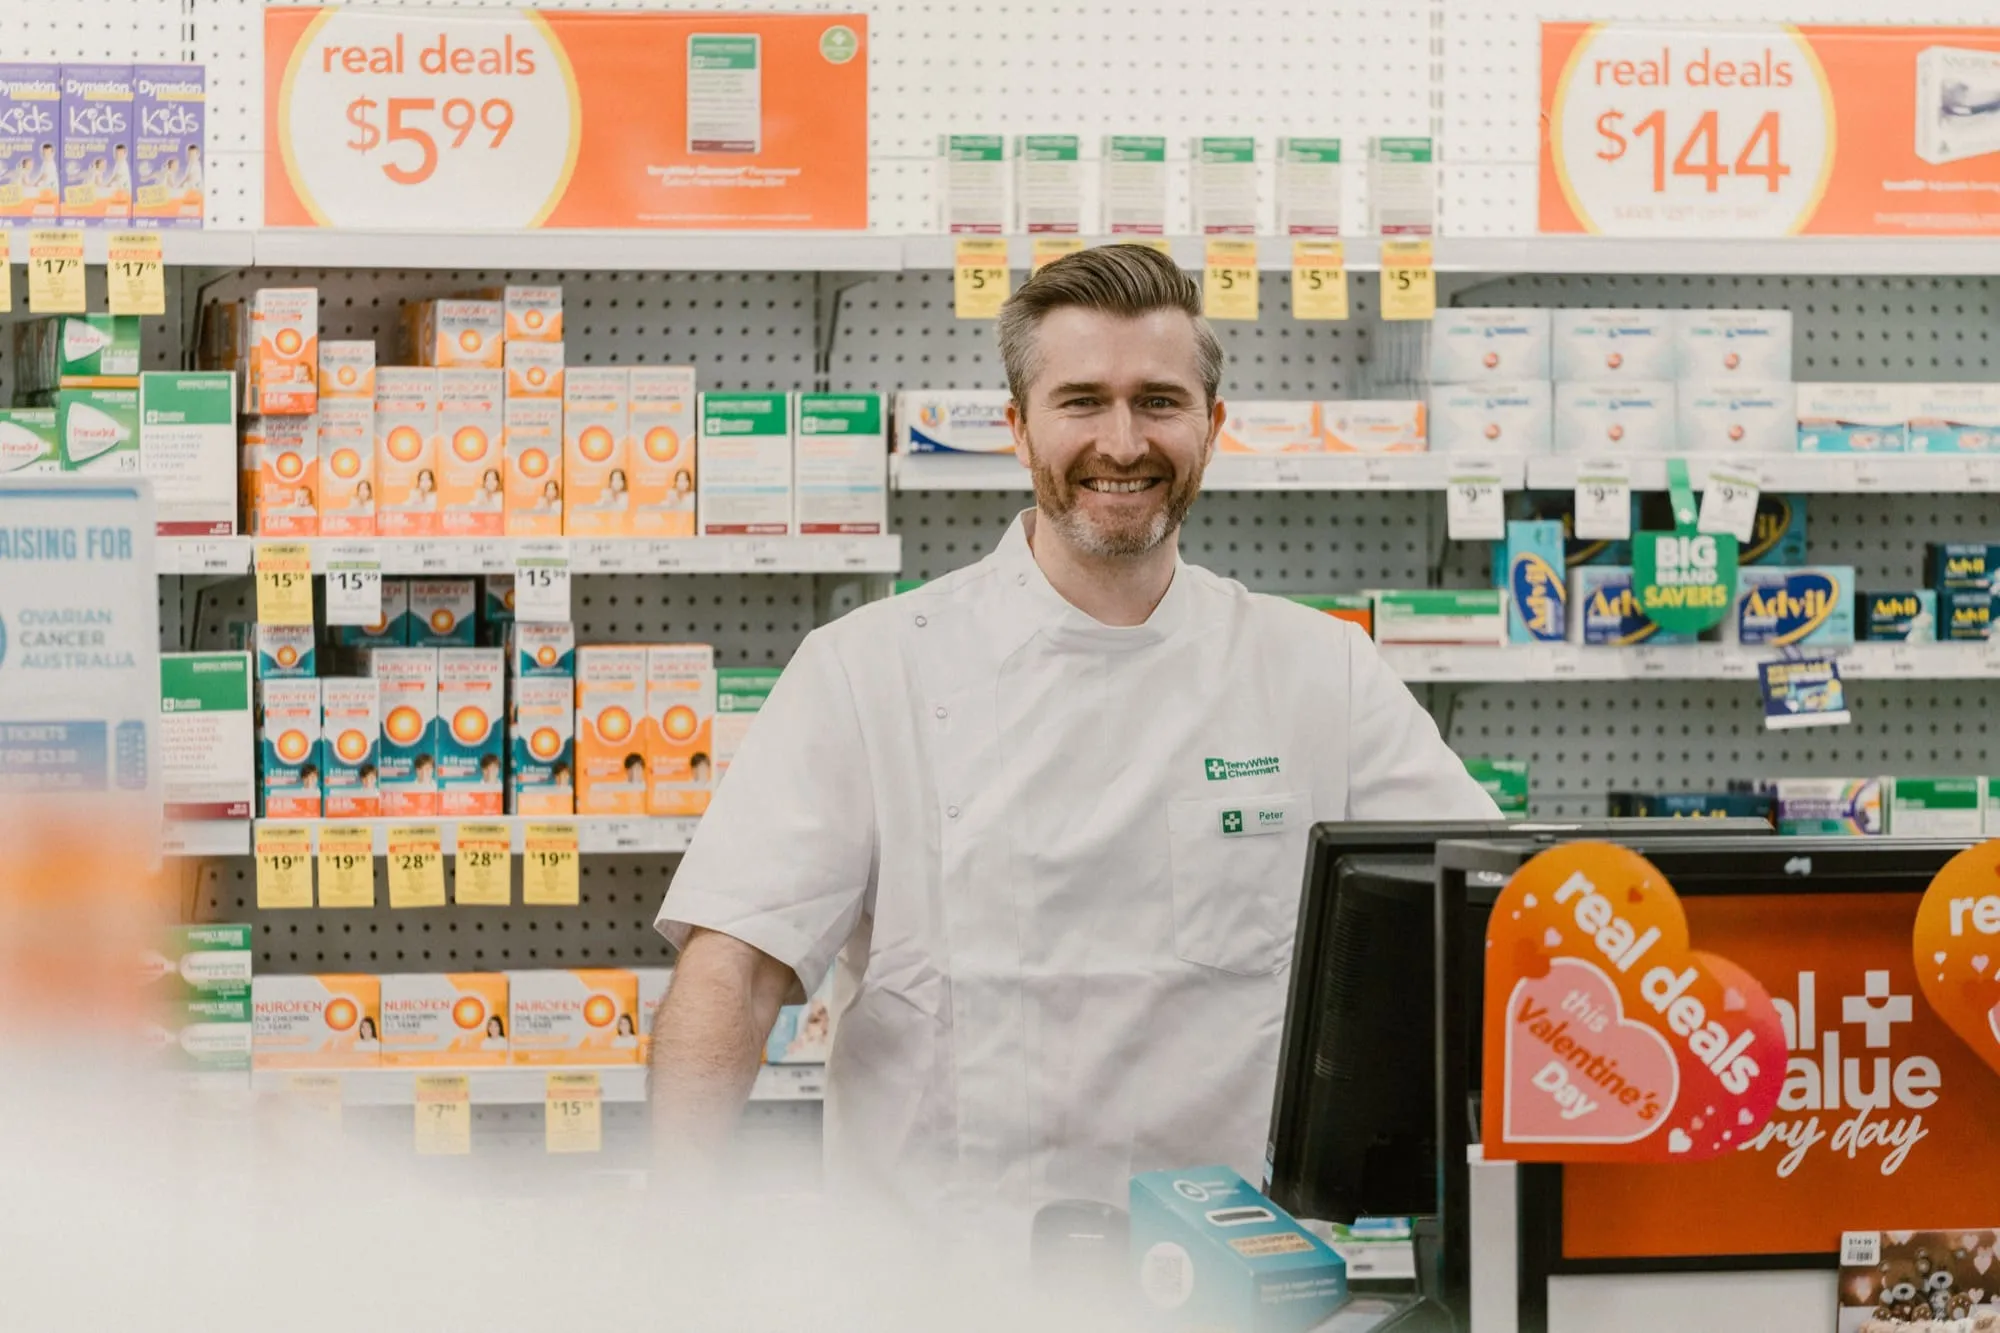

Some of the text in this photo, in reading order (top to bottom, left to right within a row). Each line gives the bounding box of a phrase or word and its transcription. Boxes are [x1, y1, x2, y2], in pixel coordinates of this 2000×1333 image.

[323, 34, 536, 75] real deals
[1595, 47, 1793, 87] real deals
[69, 105, 127, 135] Kids
[142, 105, 200, 136] Kids
[1595, 107, 1791, 194] $144
[87, 528, 133, 560] FOR
[1655, 537, 1717, 569] BIG
[1656, 569, 1717, 585] BRAND
[1587, 587, 1643, 617] Adv
[1644, 585, 1728, 607] SAVERS
[1744, 587, 1826, 618] Advil
[17, 609, 112, 626] OVARIAN
[18, 631, 105, 648] CANCER
[20, 652, 136, 669] AUSTRALIA
[1225, 756, 1280, 770] TerryWhite
[1227, 765, 1280, 778] Chemmart
[1259, 811, 1284, 821] Peter
[1554, 871, 1760, 1095] real deals
[256, 1001, 322, 1012] NUROFEN
[384, 1000, 450, 1010] NUROFEN
[1561, 989, 1604, 1033] this
[1515, 997, 1660, 1121] Valentine's
[1531, 1060, 1598, 1120] Day
[1830, 1105, 1930, 1177] day
